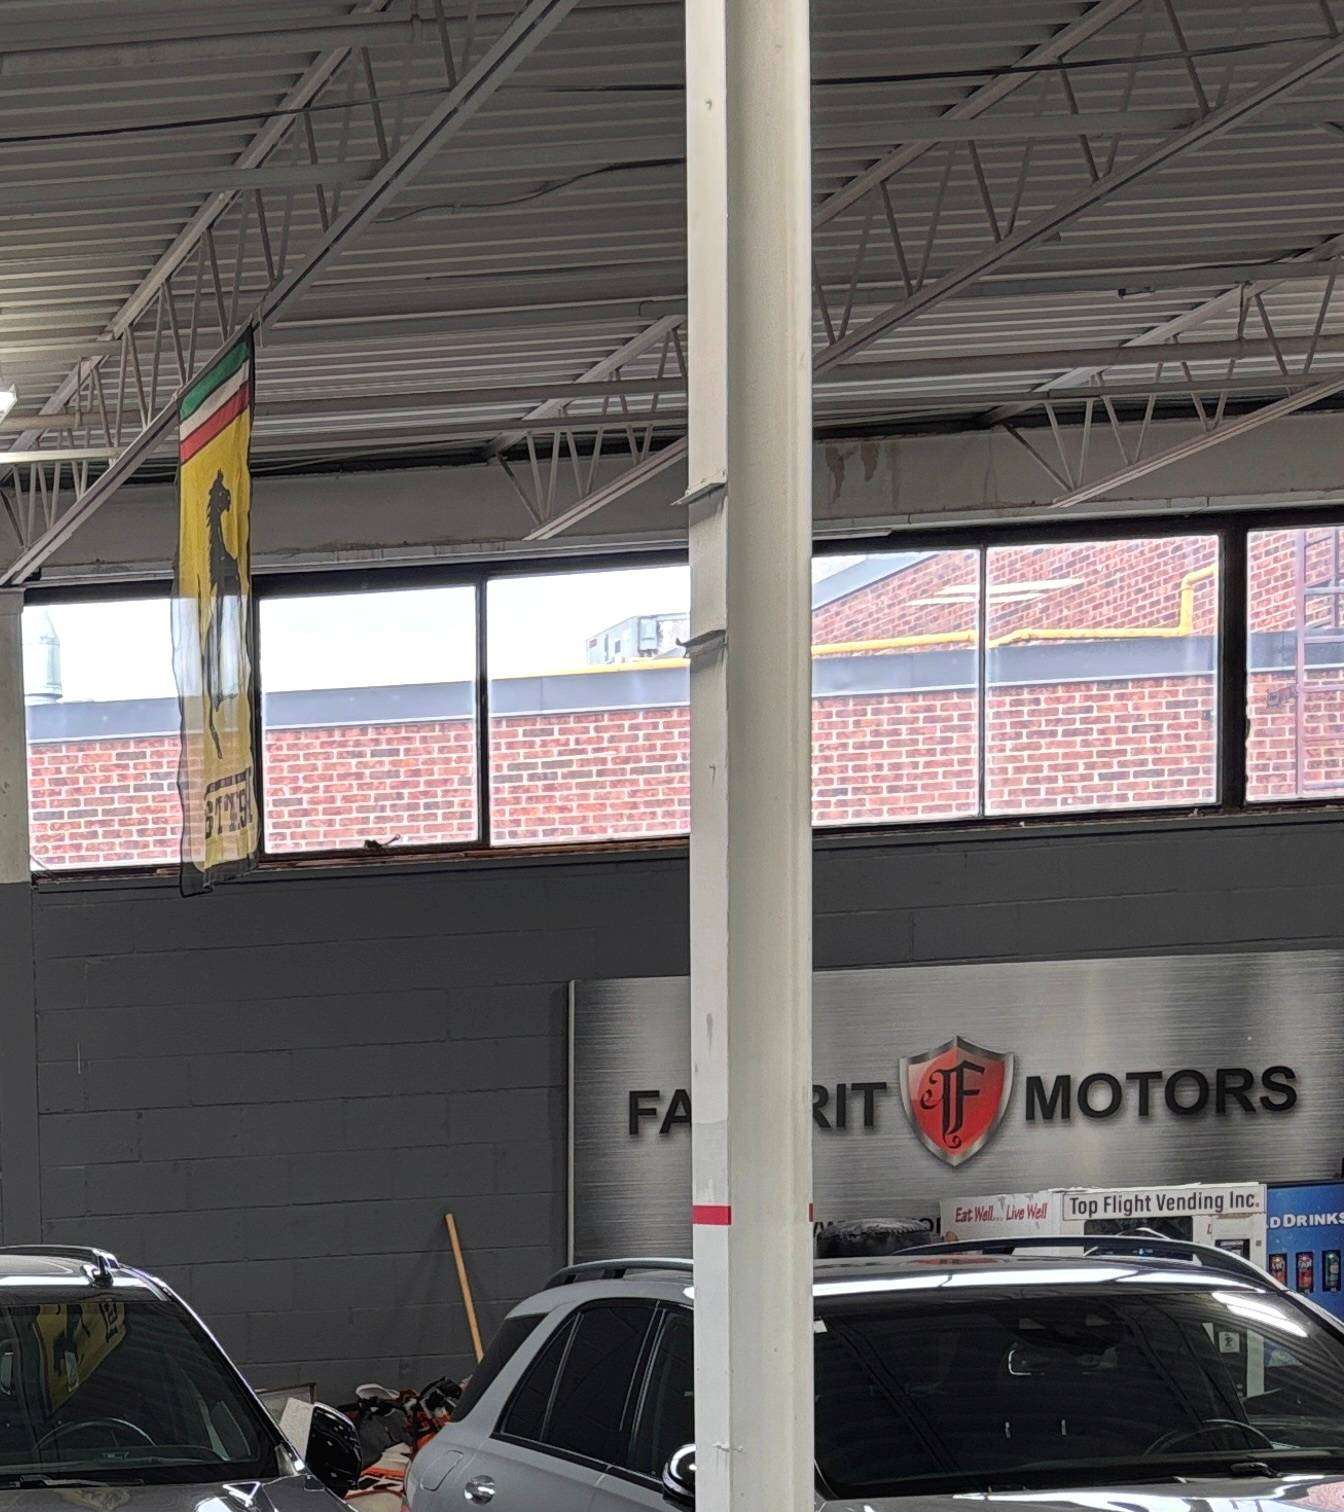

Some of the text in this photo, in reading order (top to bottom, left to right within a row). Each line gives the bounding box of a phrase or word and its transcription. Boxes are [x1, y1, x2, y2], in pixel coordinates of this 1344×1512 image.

[627, 1082, 887, 1135] FARIT
[1025, 1065, 1298, 1121] MOTORS
[955, 1206, 973, 1222] Eat
[1006, 1203, 1025, 1220] Live
[1027, 1202, 1048, 1219] Well
[1069, 1191, 1260, 1217] Top Flight Vending Inc.
